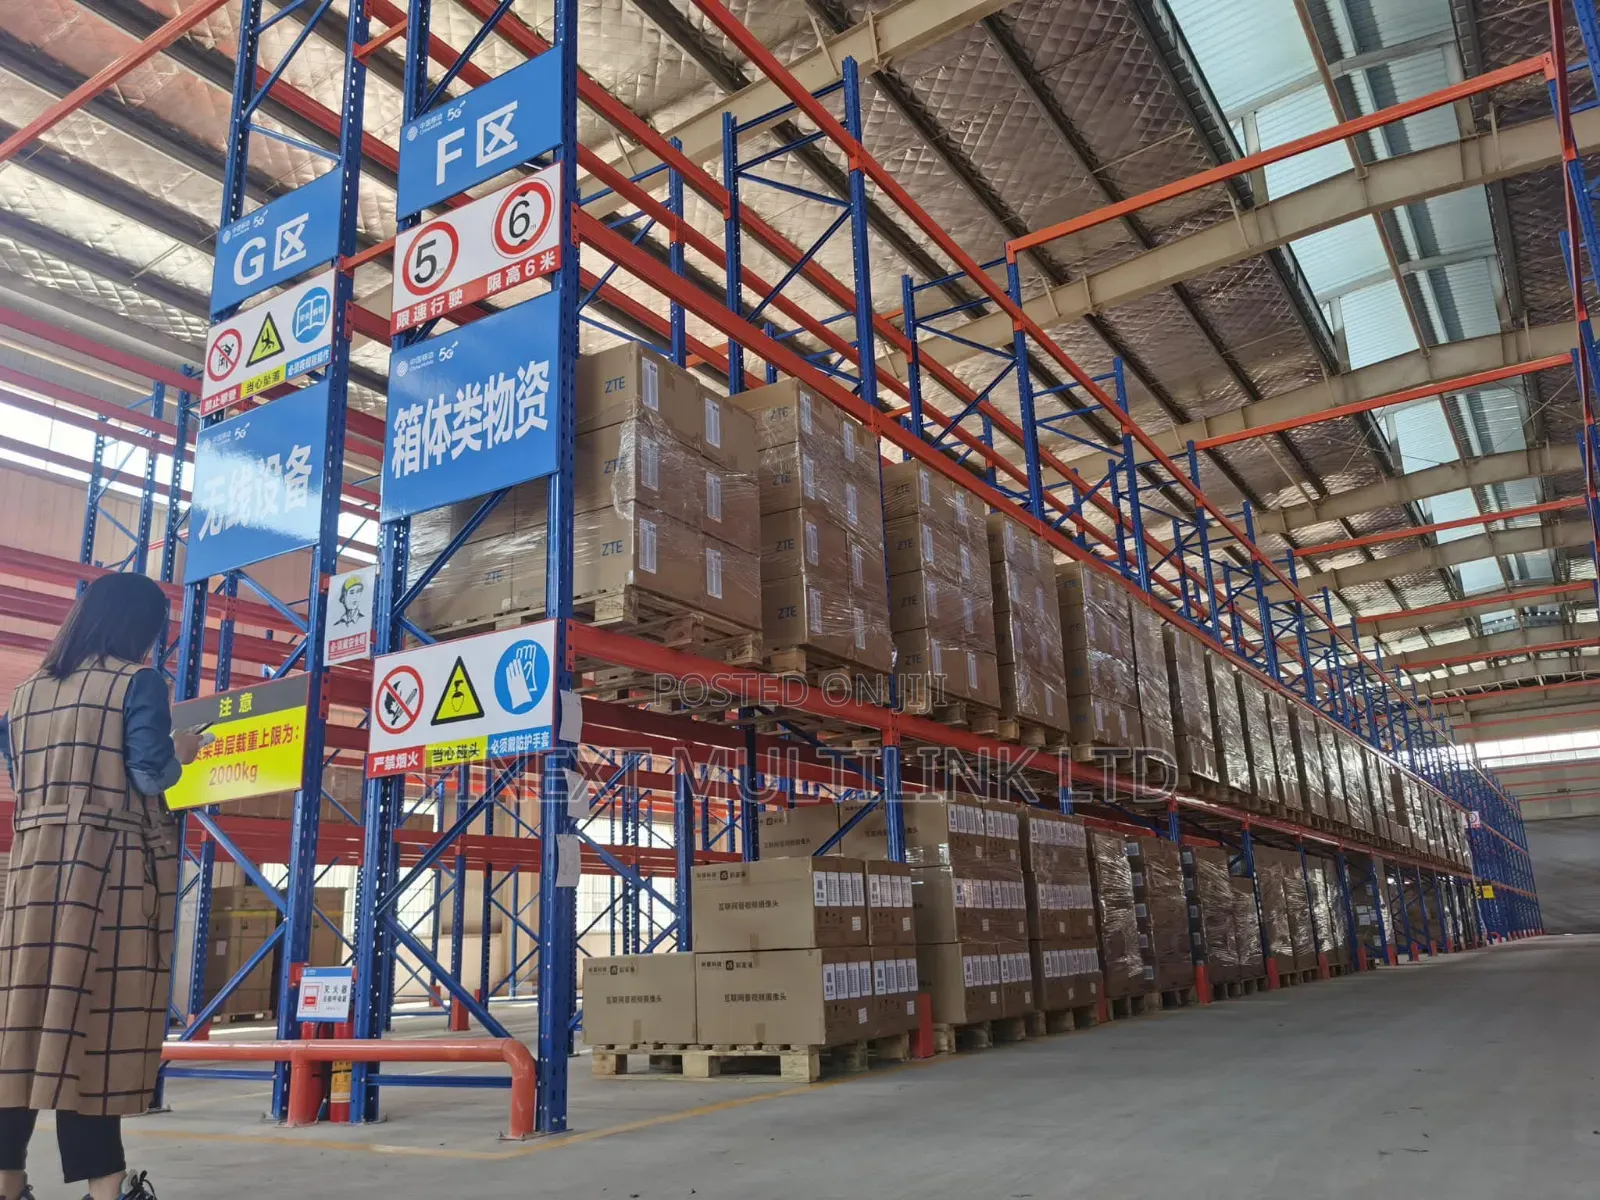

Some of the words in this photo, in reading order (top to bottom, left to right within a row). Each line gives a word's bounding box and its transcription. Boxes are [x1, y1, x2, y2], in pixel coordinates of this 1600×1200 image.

[447, 106, 462, 122] 5G
[436, 100, 518, 187] F区
[509, 199, 530, 239] 6
[233, 211, 310, 286] G区
[414, 238, 437, 284] 5
[396, 289, 463, 331] 限速行驶
[487, 250, 556, 294] 限高6米
[438, 347, 454, 362] 5G
[605, 376, 626, 394] ZTE
[391, 359, 550, 479] 箱体类物资
[770, 406, 789, 422] ZTE
[234, 427, 247, 441] 5G
[601, 539, 623, 557] ZTE
[776, 538, 795, 552] ZTE
[897, 537, 914, 551] ZTE
[778, 605, 798, 620] ZTE
[905, 652, 923, 666] ZTE
[219, 692, 253, 718] 注意
[490, 731, 550, 755] 必须戴防护手套
[373, 751, 419, 772] 严禁烟火
[432, 742, 480, 763] 当心碰头
[208, 761, 258, 786] 2000kg
[718, 899, 780, 911] 互联网音视频摄像头
[606, 995, 663, 1006] 互联网音视频摄像头
[724, 992, 788, 1004] 互联网音视频摄像头
